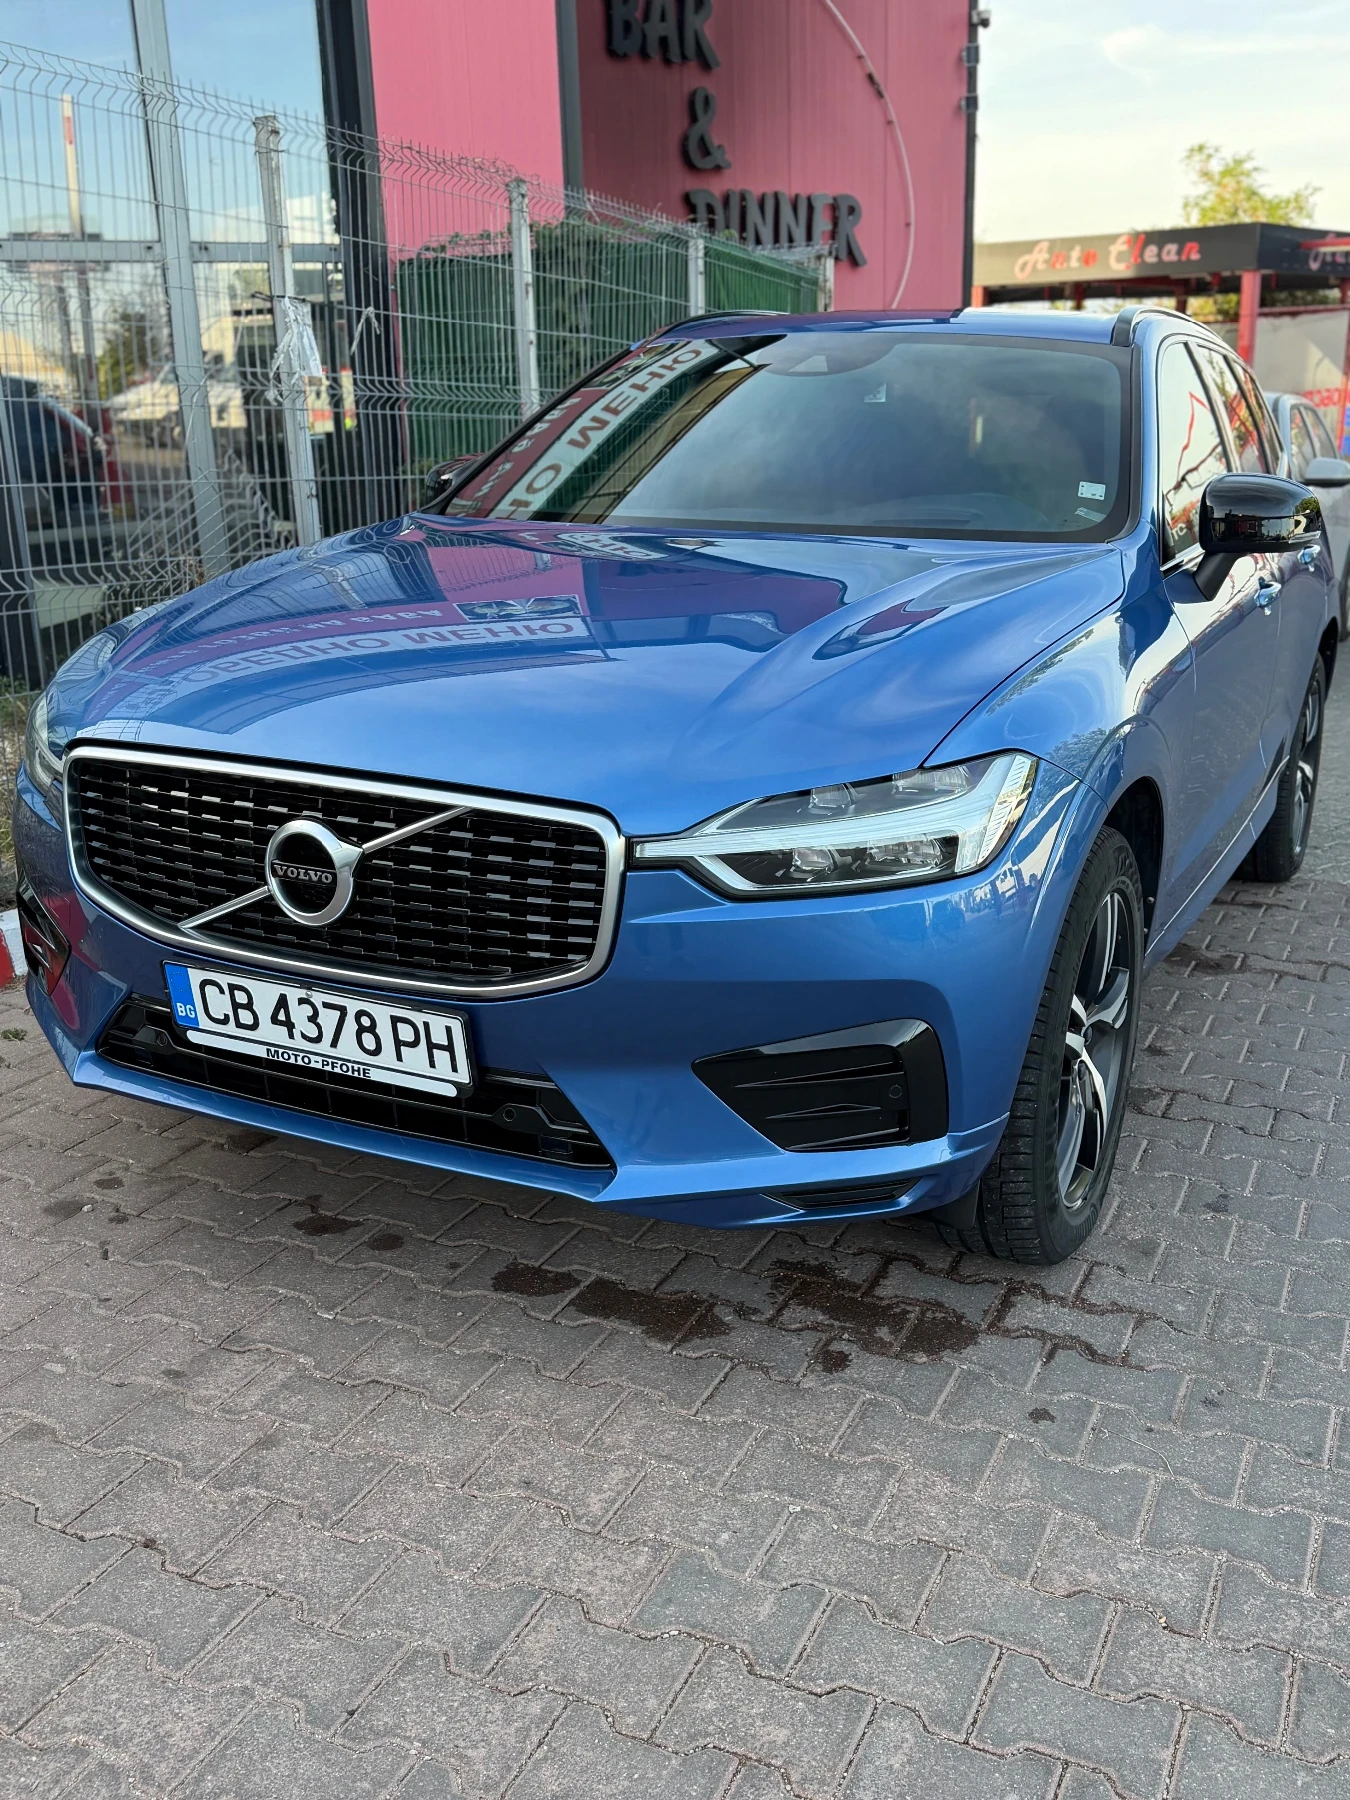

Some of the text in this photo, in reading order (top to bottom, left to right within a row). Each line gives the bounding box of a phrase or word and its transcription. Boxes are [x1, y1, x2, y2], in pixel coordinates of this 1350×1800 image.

[606, 0, 720, 69] BAR
[682, 86, 732, 173] &
[687, 189, 867, 267] DINNER
[1014, 233, 1201, 280] Auto Clean
[273, 864, 333, 884] VOLVO
[176, 1002, 196, 1019] BG
[270, 993, 383, 1057] 4378
